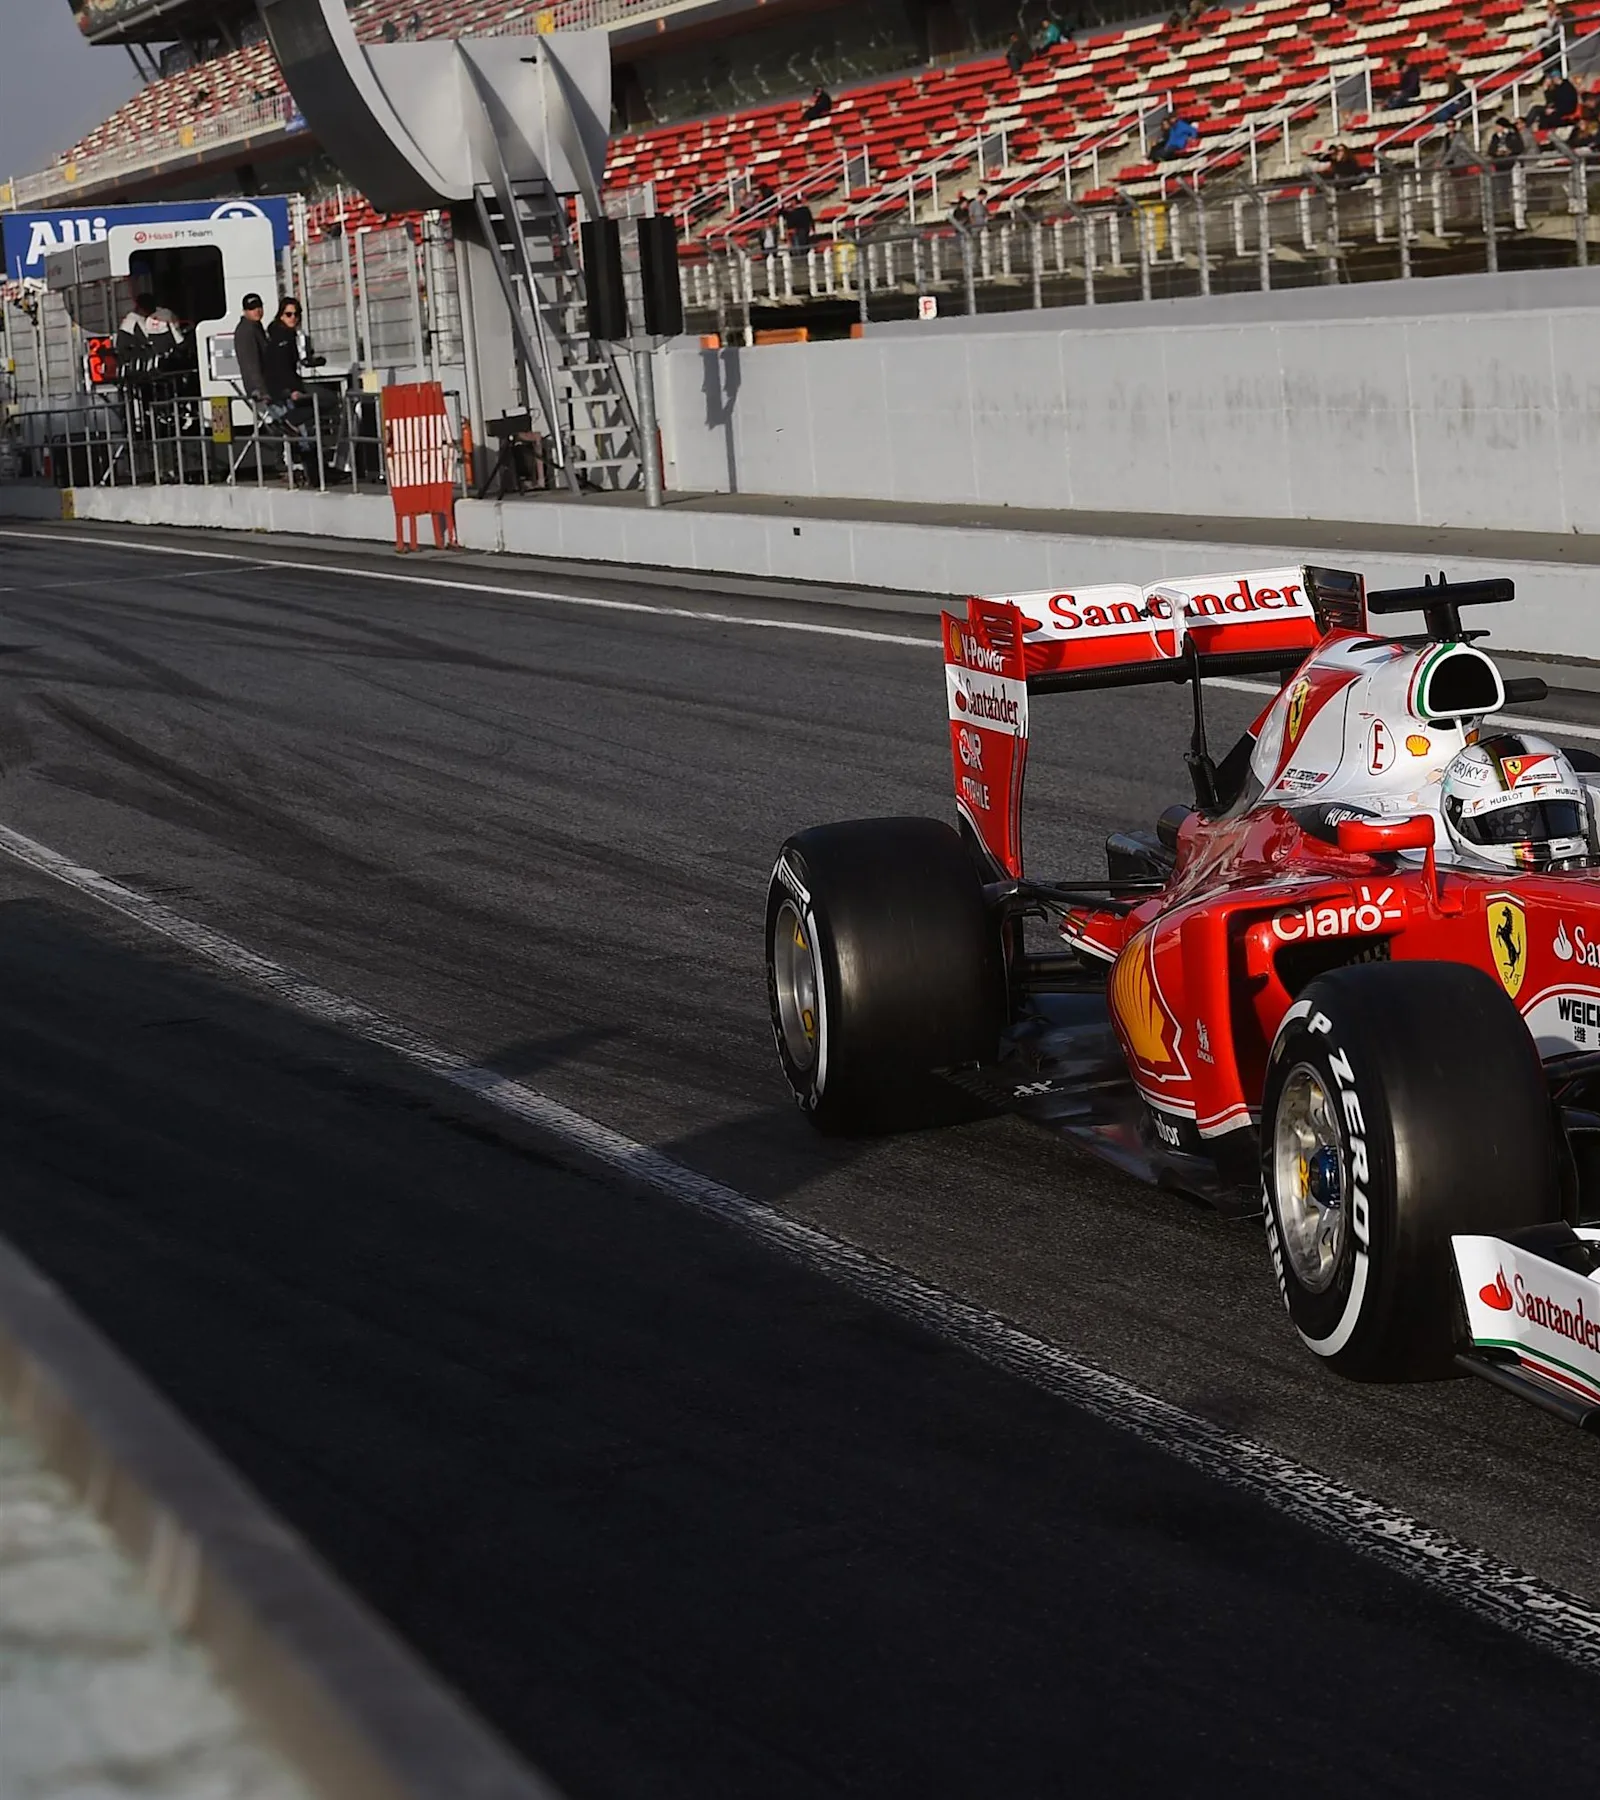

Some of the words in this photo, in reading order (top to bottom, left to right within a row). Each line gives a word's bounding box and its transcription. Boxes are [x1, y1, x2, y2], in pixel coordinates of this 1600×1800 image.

[26, 217, 107, 265] Alli
[175, 230, 185, 238] F1
[187, 229, 213, 238] Team
[1048, 579, 1302, 631] Santnder
[961, 633, 1006, 673] V-Power
[965, 677, 1019, 726] Santander
[1372, 724, 1384, 769] E
[1489, 791, 1524, 806] HUBLOT
[1272, 904, 1382, 941] Claro
[1307, 1011, 1333, 1036] P
[1328, 1047, 1371, 1249] ZERO
